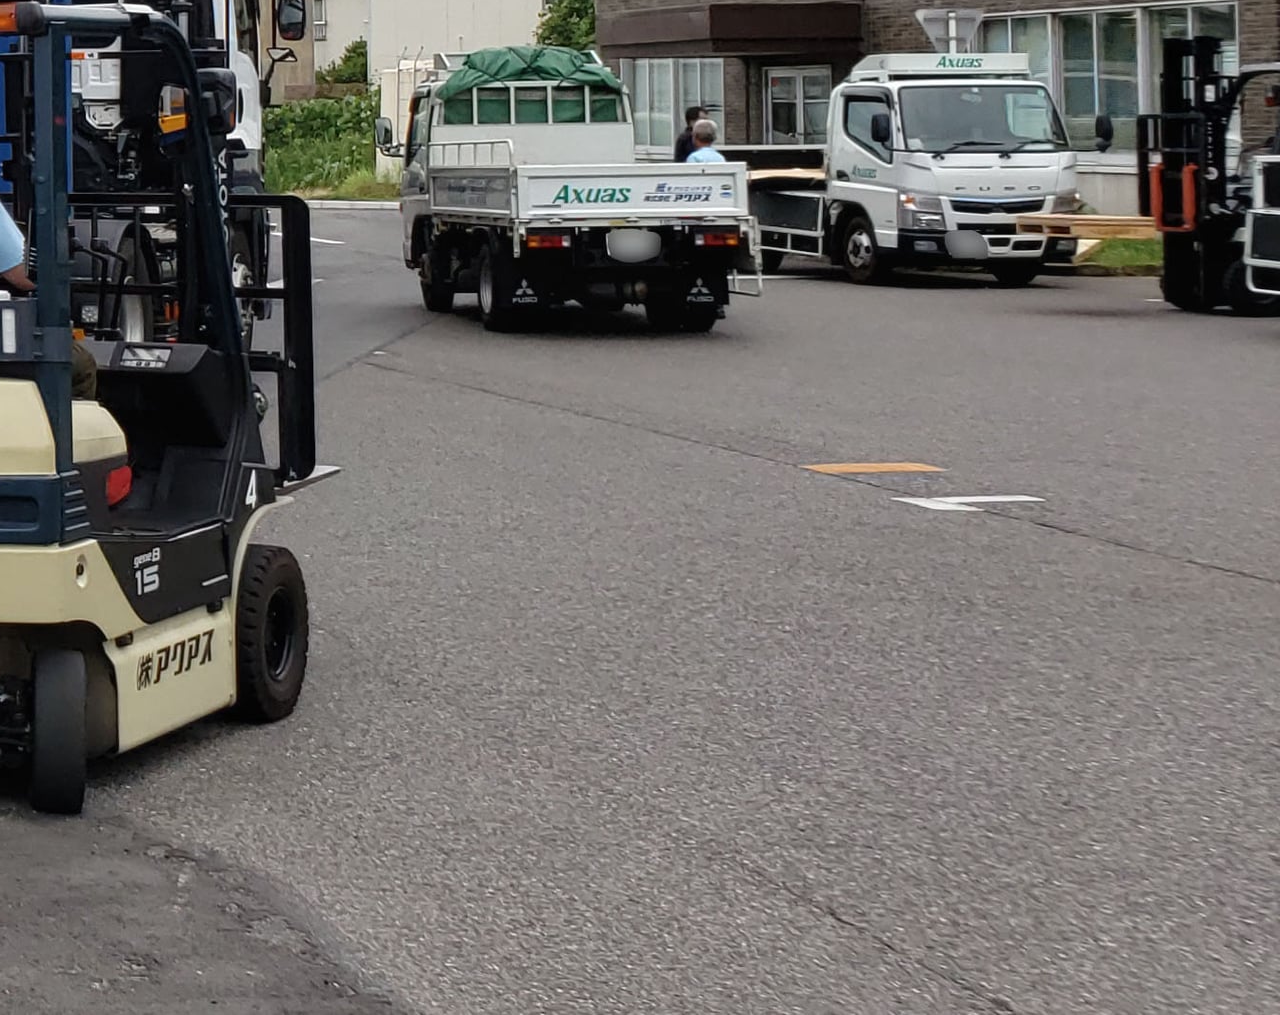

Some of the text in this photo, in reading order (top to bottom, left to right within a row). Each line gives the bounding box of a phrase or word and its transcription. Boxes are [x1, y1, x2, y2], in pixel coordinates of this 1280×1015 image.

[936, 56, 984, 68] Axuas
[552, 184, 632, 204] Axuas
[512, 296, 538, 304] FUSO
[686, 295, 714, 303] FUSO
[245, 469, 257, 508] 4
[135, 565, 160, 596] 15
